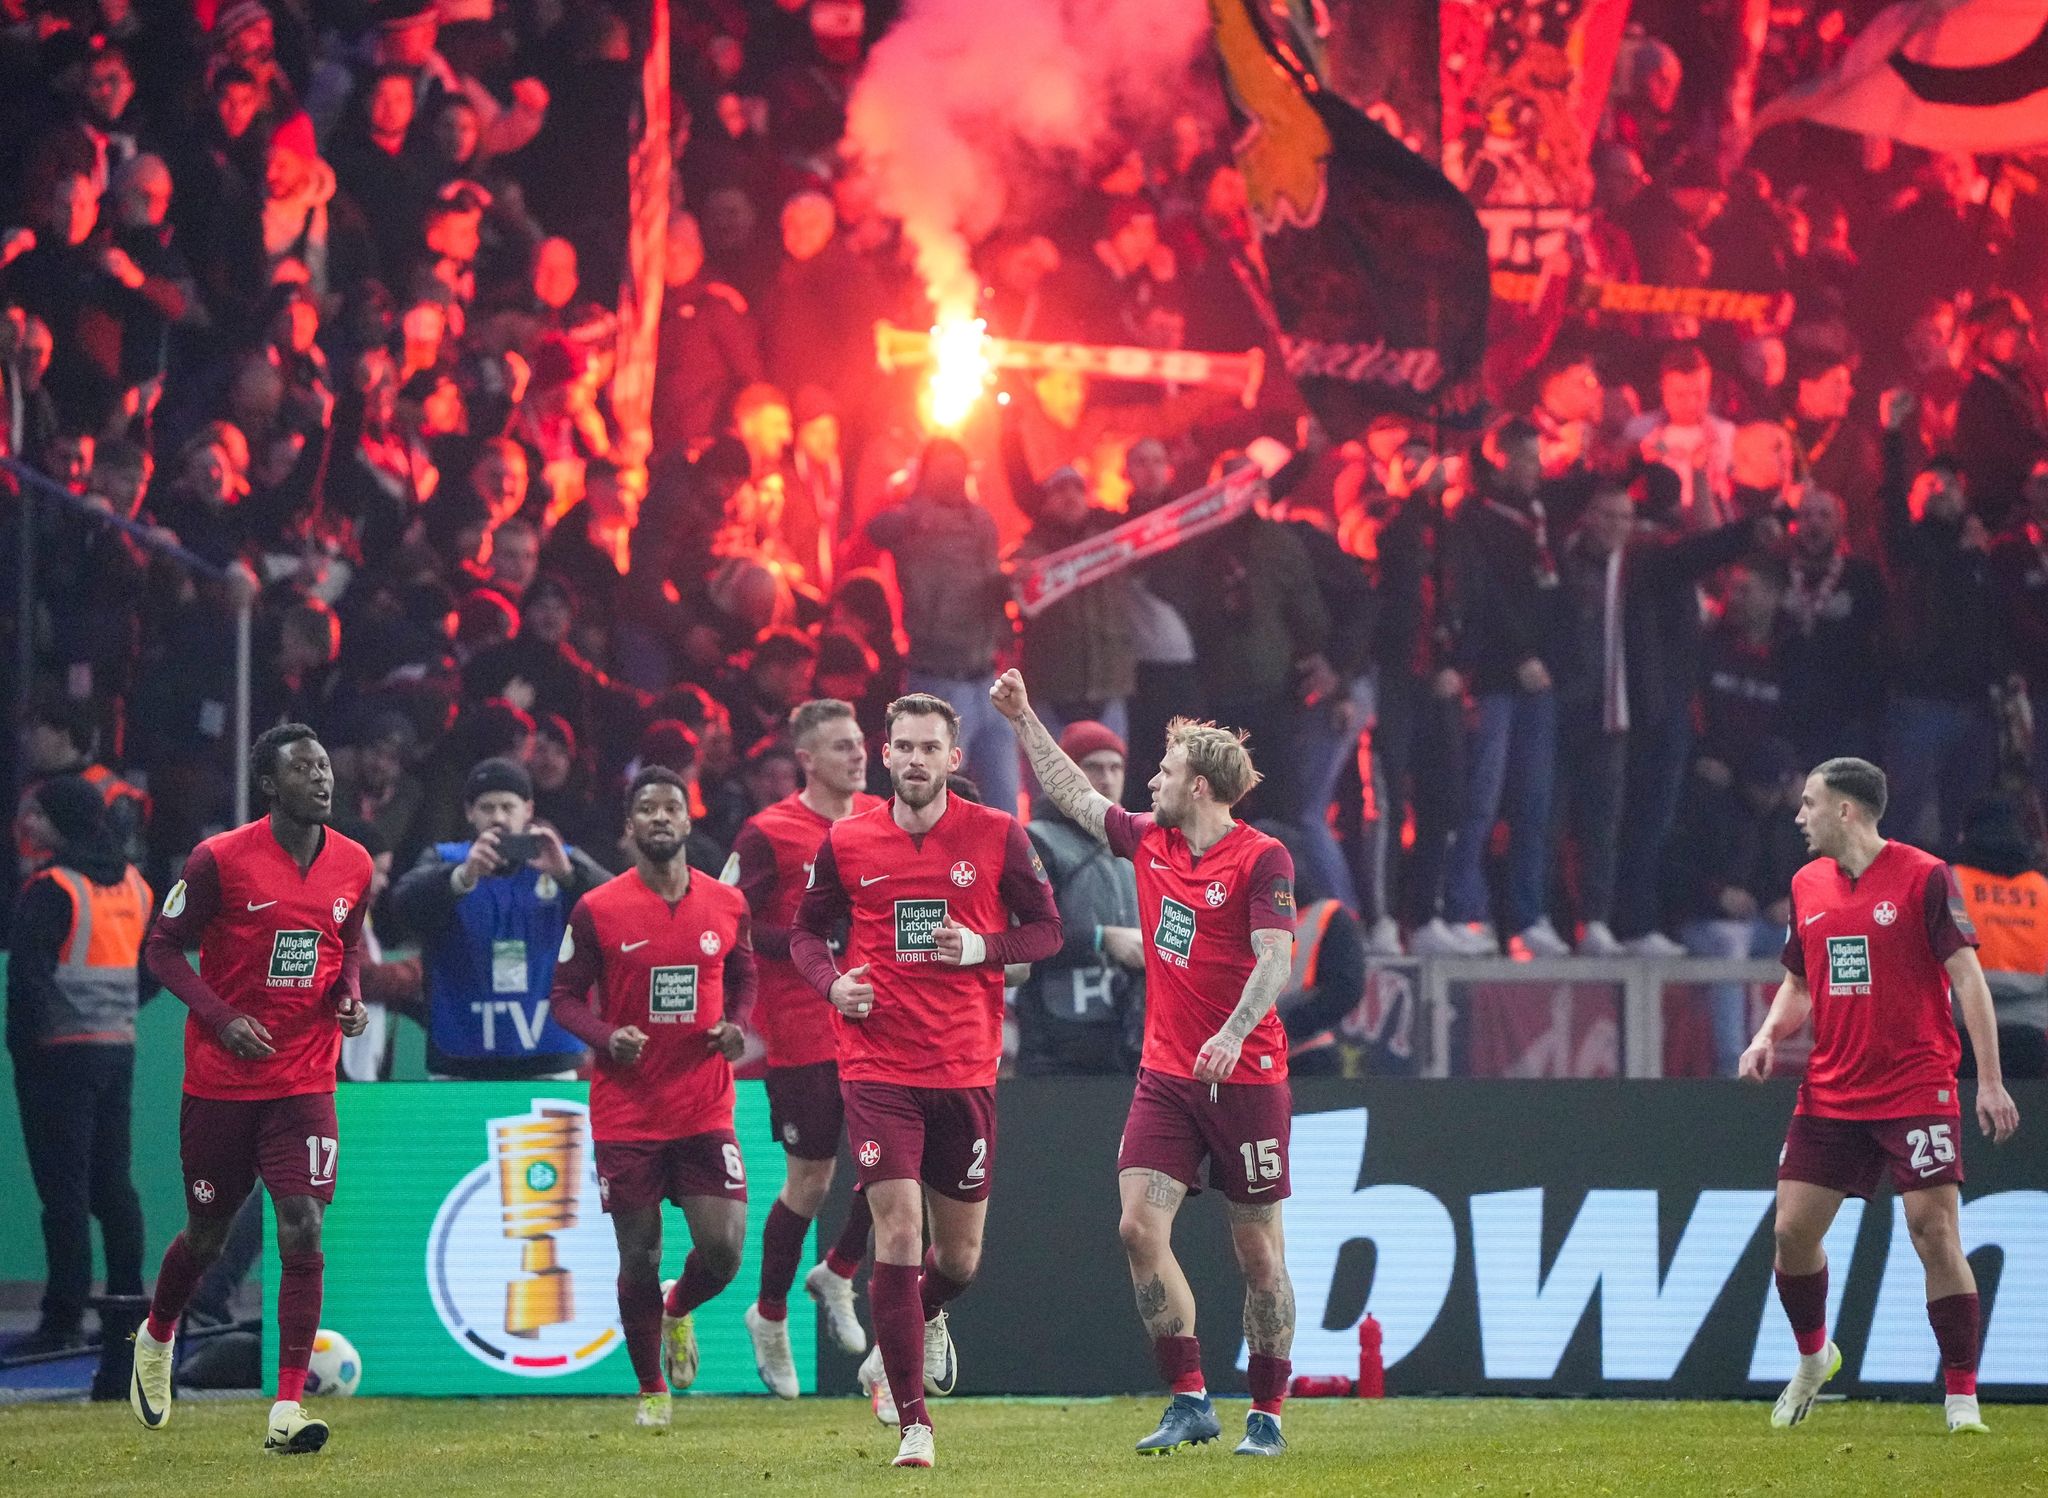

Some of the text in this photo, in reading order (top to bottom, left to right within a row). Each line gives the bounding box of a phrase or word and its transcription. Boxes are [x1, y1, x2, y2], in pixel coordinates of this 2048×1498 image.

[901, 907, 942, 920] Allgäuer
[900, 919, 943, 932] Latschen
[279, 936, 314, 950] Allgäuer
[276, 949, 315, 960] Latschen
[896, 952, 927, 962] MOBIL
[1832, 955, 1866, 967] Latschen
[1175, 957, 1190, 969] GEL
[265, 978, 313, 988] MOBIL GEL
[471, 999, 550, 1051] TV
[1906, 1124, 1956, 1168] 25
[306, 1135, 338, 1178] 17
[721, 1143, 745, 1181] 6
[966, 1137, 987, 1179] 2
[1239, 1138, 1283, 1182] 15
[1235, 1107, 2048, 1384] bwin
